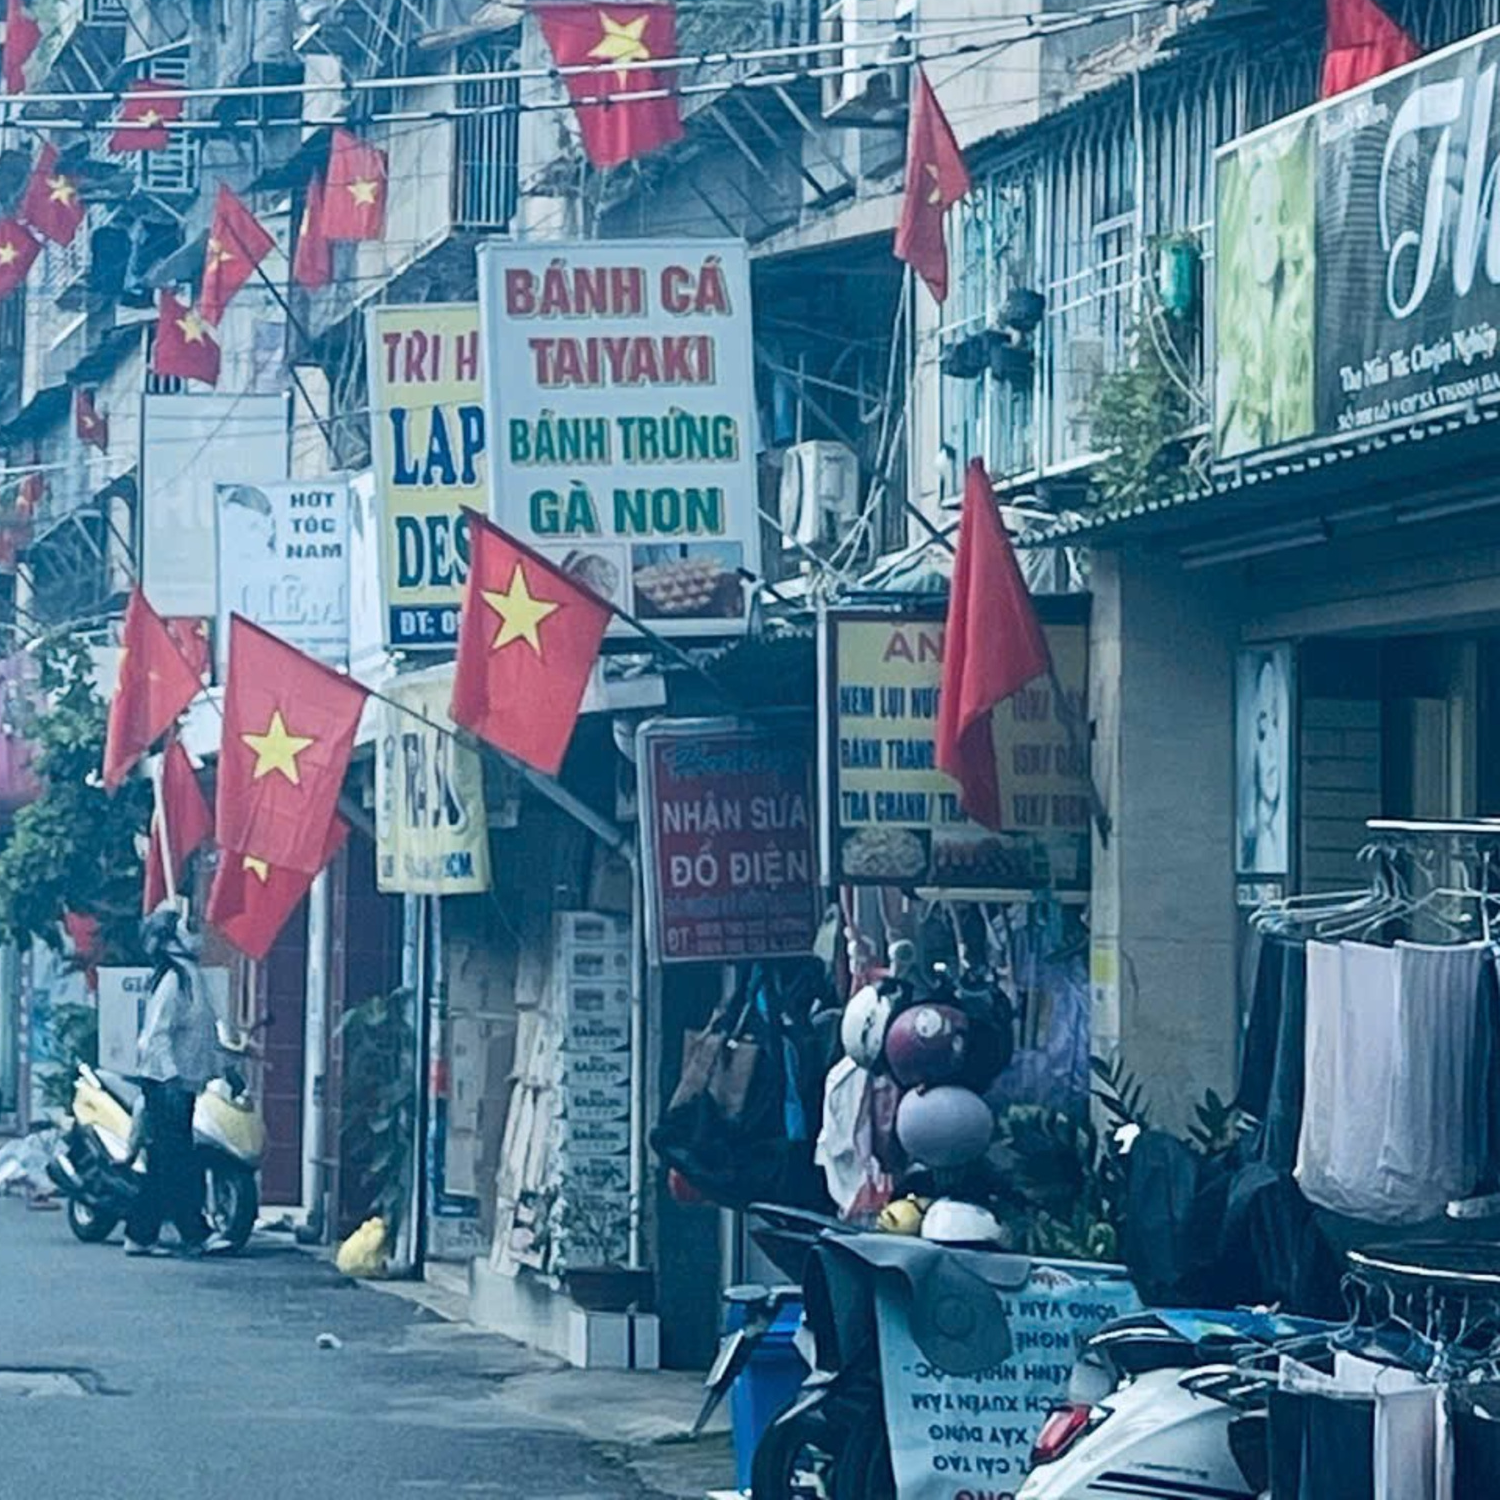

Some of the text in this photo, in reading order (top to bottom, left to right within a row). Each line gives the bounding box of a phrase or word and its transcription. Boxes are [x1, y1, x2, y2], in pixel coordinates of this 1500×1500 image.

[505, 255, 731, 317] BÁNH CÁ
[528, 335, 715, 386] TAIYAKI
[509, 406, 738, 465] BÁNH TRỨNG
[529, 480, 723, 536] GÀ NON
[286, 543, 342, 558] NAM
[662, 789, 742, 837] NHẬN
[729, 839, 810, 892] ĐIỆN
[989, 1426, 1029, 1450] XÂY
